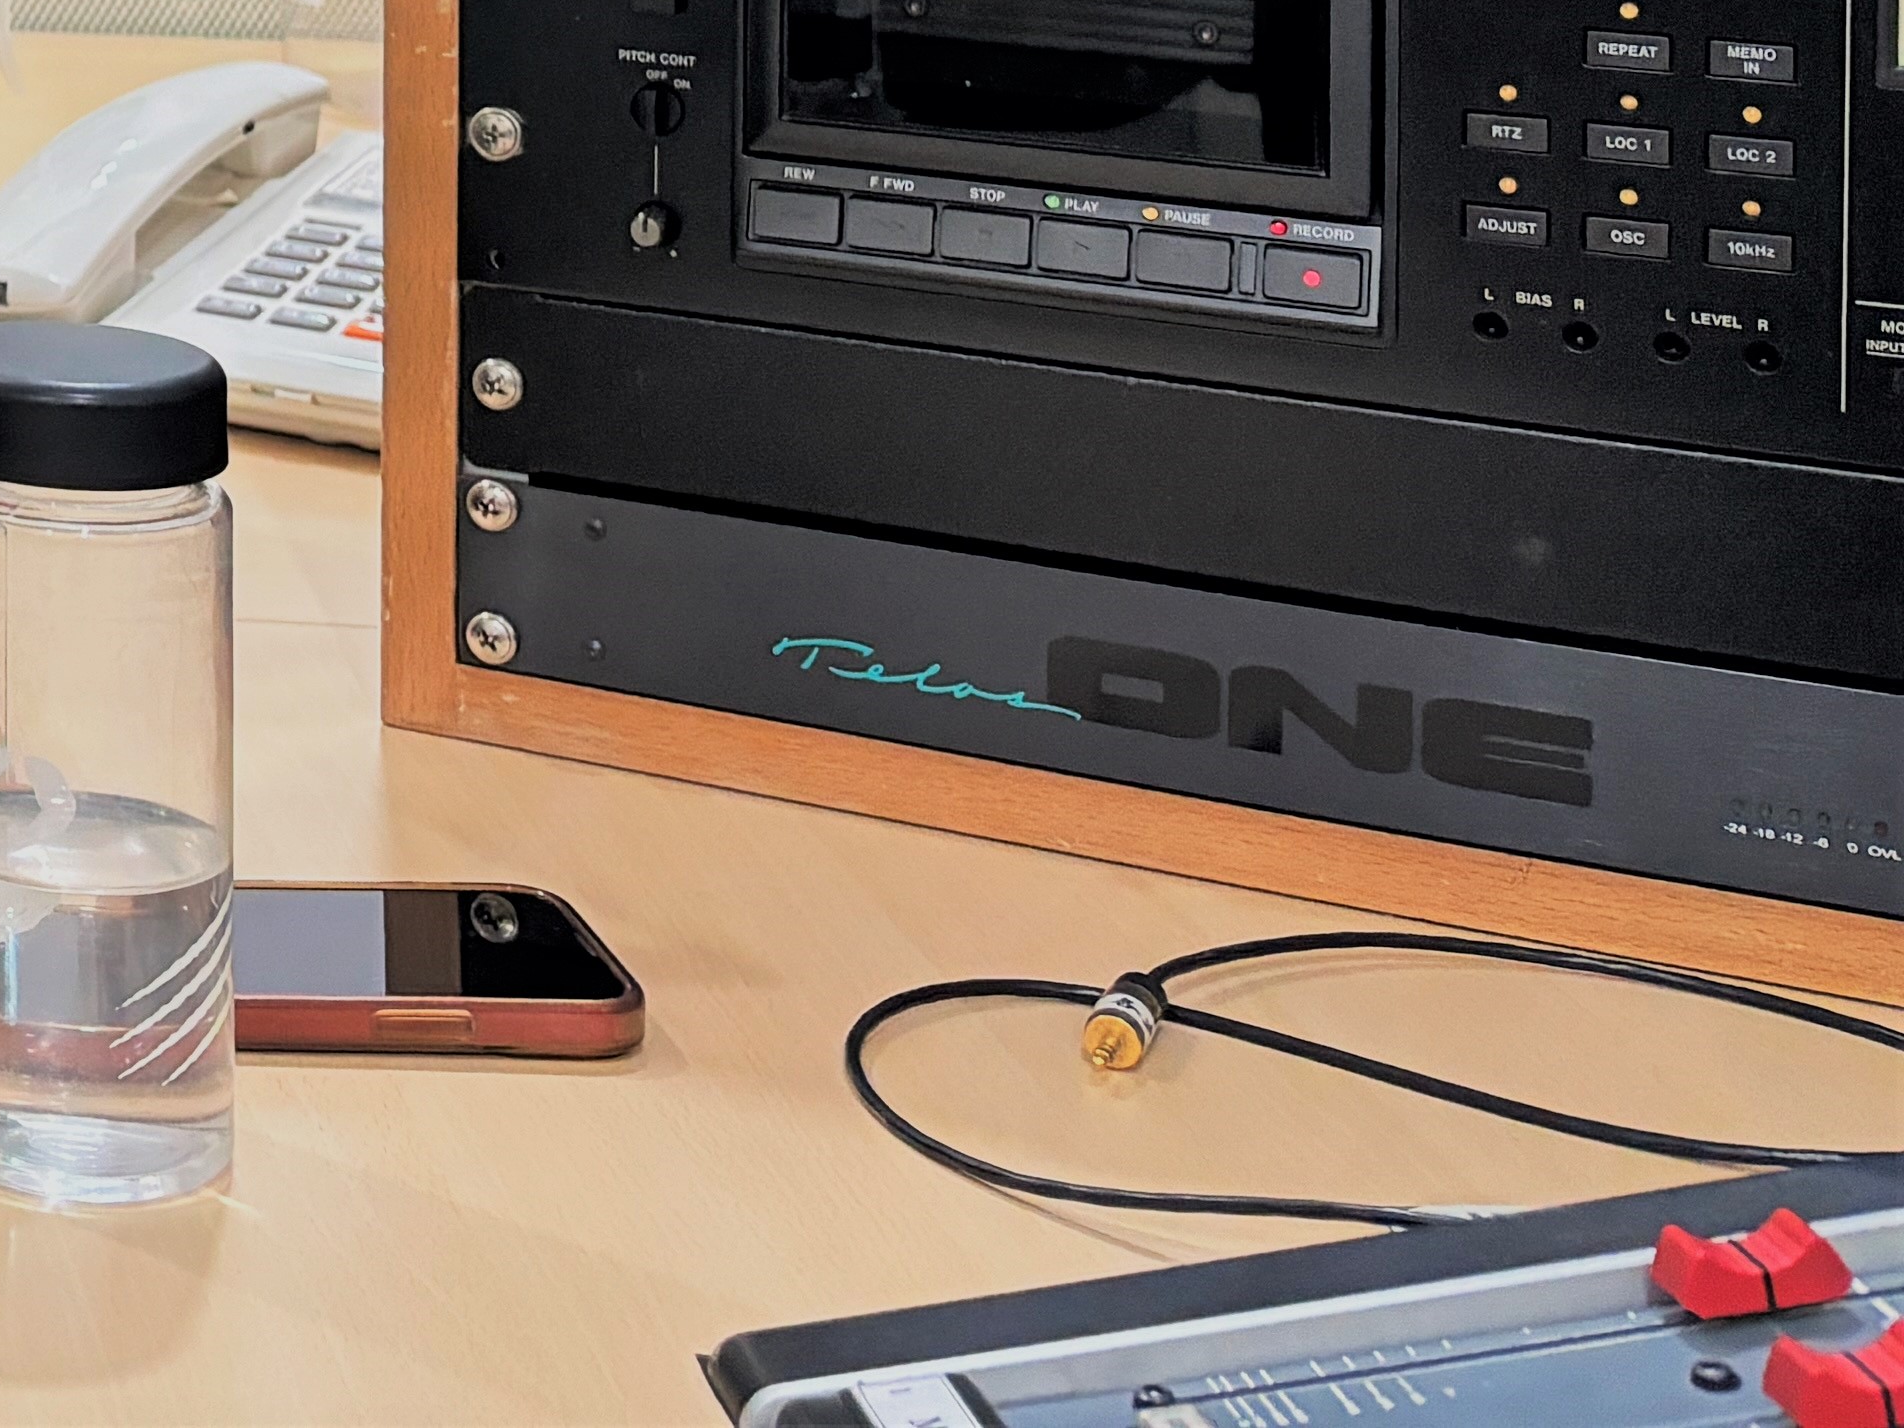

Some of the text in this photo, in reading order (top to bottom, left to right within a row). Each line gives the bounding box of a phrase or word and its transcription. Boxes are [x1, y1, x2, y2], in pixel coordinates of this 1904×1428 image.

[617, 48, 697, 68] PITCH CONT
[1597, 41, 1659, 60] REPEAT
[1726, 45, 1778, 63] MEMO
[645, 68, 668, 81] OFF
[1742, 60, 1761, 76] IN
[672, 77, 692, 90] ON
[1491, 124, 1523, 141] RTZ
[1604, 135, 1653, 153] LOC 1
[1726, 146, 1777, 165] LOC 2
[782, 164, 816, 182] REW
[883, 177, 916, 194] FWD
[967, 186, 1008, 206] STOP
[1062, 196, 1100, 216] PLAY
[1163, 208, 1212, 228] PAUSE
[1477, 217, 1538, 237] ADJUST
[1291, 221, 1356, 244] RECORD
[1609, 228, 1646, 246] OSC
[1726, 240, 1776, 260] 10kHz
[1483, 286, 1586, 312] L BIAS R
[1665, 307, 1770, 333] L LEVEL R
[771, 634, 1083, 722] Telos
[1045, 633, 1594, 808] ONE
[1723, 821, 1748, 836] -24
[1780, 831, 1804, 846] -12
[1846, 841, 1859, 855] 0
[1867, 844, 1903, 862] OVL
